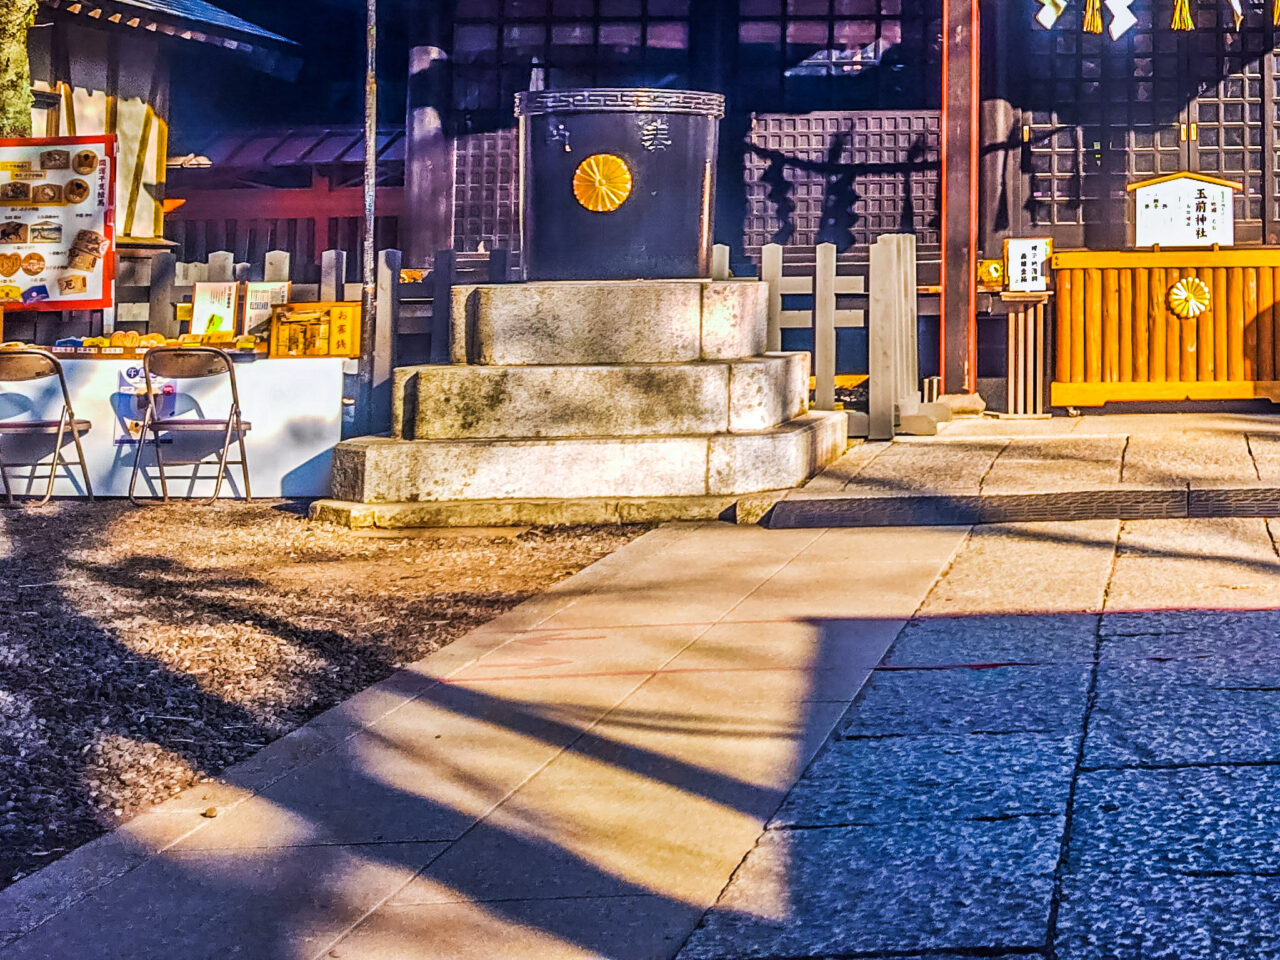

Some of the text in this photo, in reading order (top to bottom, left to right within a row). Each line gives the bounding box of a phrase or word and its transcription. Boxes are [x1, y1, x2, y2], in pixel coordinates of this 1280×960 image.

[97, 159, 106, 207] 開運干支絵馬
[1195, 188, 1207, 239] 玉前神社
[64, 279, 75, 290] 厄
